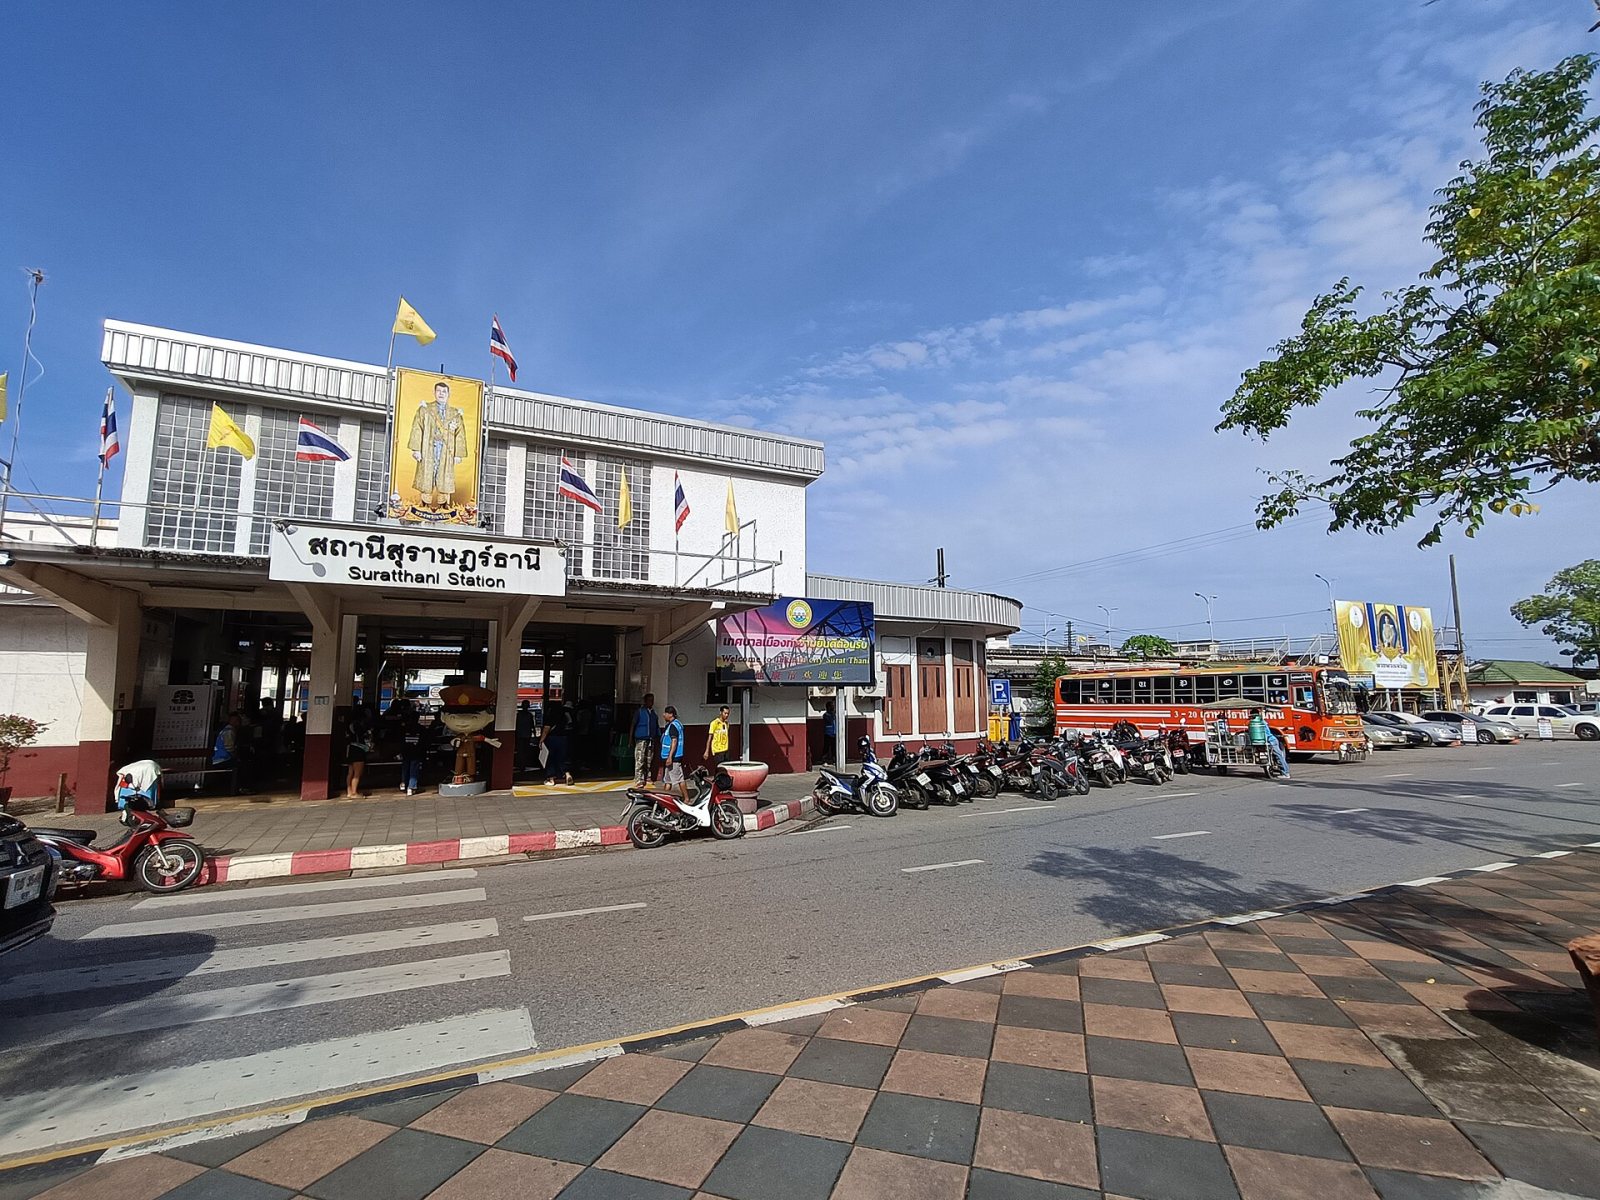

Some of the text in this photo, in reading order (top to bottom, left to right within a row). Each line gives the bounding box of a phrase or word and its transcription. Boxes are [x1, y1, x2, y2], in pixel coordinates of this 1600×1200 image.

[308, 534, 541, 572] สถานีสุราษฎร์ธานี
[348, 566, 506, 589] Suratthani Station
[722, 654, 761, 663] Welcome
[849, 656, 870, 664] Thani
[993, 683, 1004, 698] P
